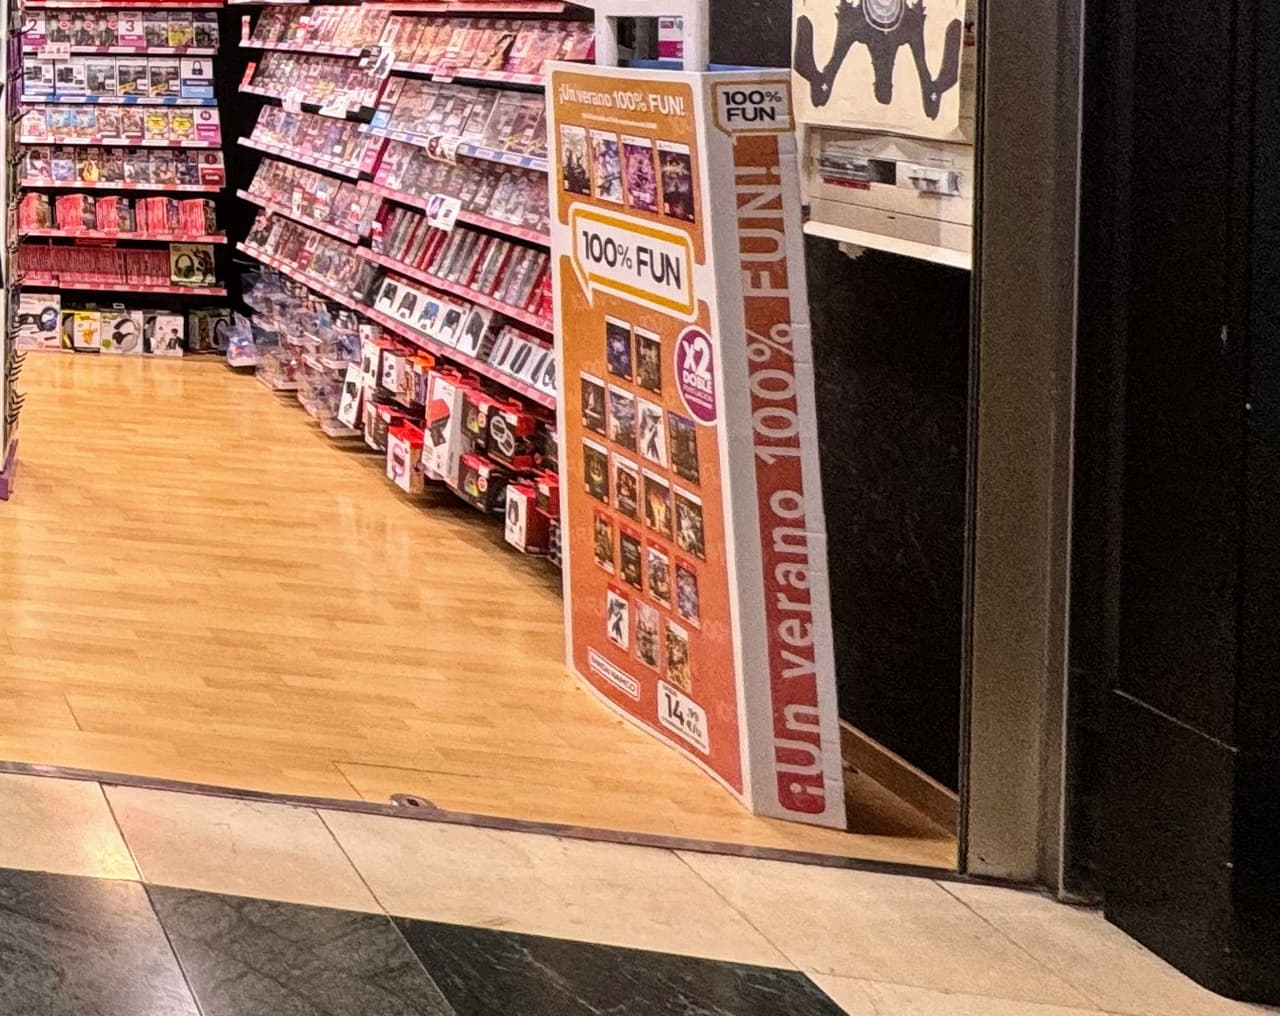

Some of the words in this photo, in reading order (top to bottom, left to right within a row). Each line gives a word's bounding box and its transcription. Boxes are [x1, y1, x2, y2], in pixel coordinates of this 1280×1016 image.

[576, 88, 612, 108] verano
[612, 90, 647, 113] 100%
[647, 94, 686, 117] FUN!
[723, 89, 783, 106] 100%
[726, 106, 777, 123] FUN
[581, 229, 633, 271] 100%
[636, 245, 682, 290] FUN
[734, 166, 789, 299] FUN!
[682, 369, 713, 395] DOBLE
[746, 322, 802, 467] 100%
[768, 488, 817, 681] verano
[774, 708, 826, 799] ¡Un
